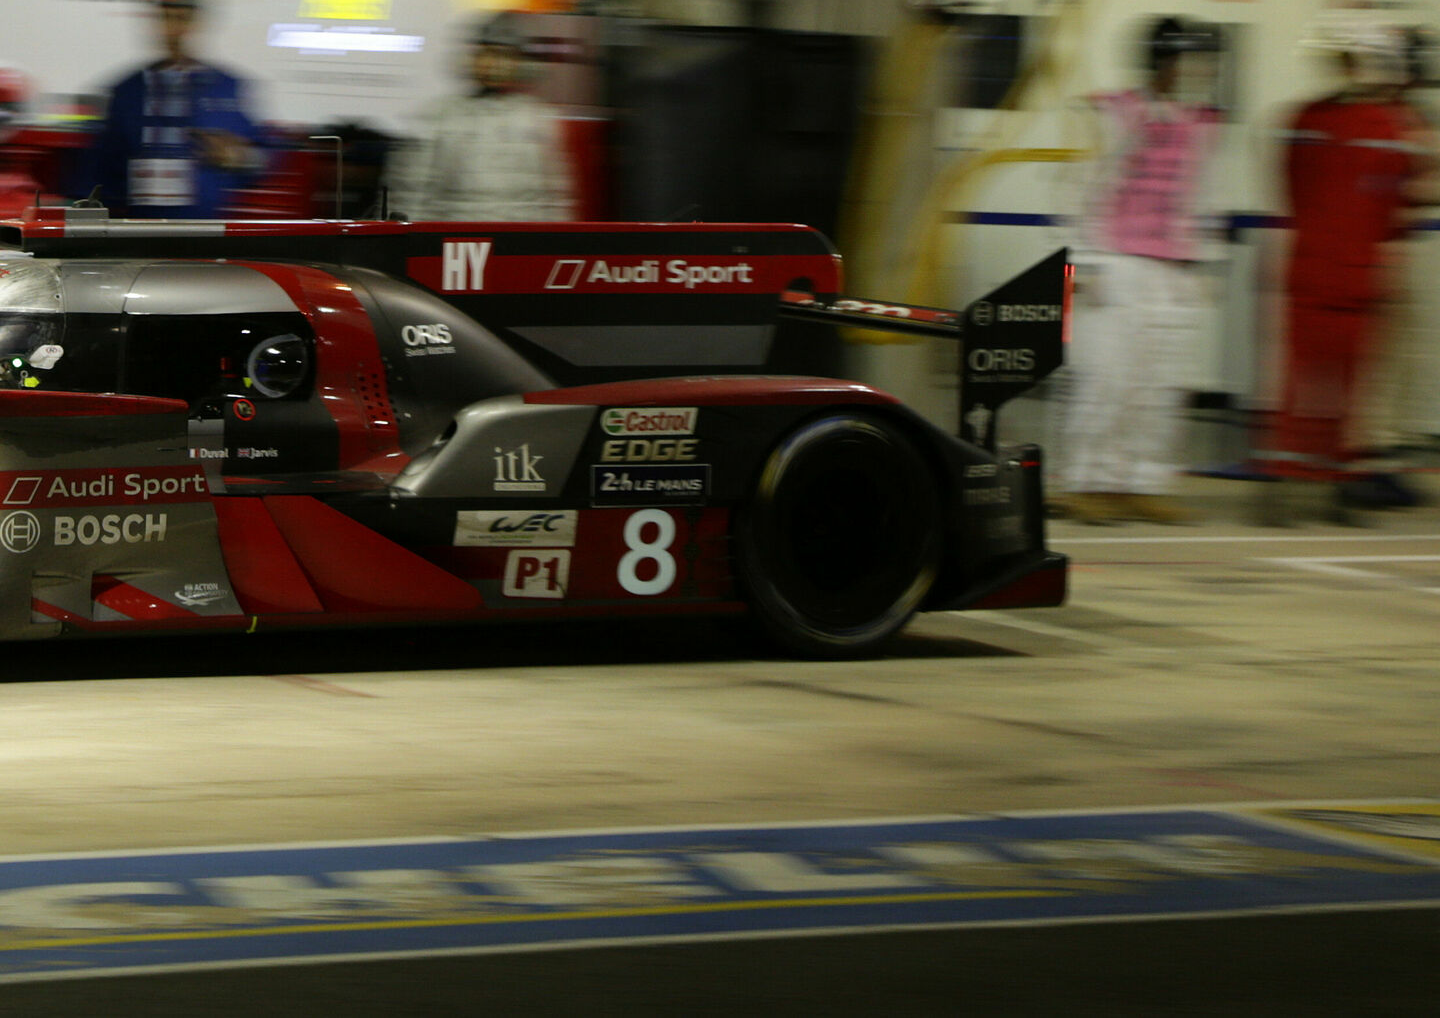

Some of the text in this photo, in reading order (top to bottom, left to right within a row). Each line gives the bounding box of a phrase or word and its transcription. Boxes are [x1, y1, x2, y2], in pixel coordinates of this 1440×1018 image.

[442, 241, 491, 291] HY
[586, 259, 753, 289] Audi Sport
[997, 304, 1062, 323] BOSCH
[401, 323, 453, 346] ORIS
[968, 347, 1036, 372] ORIS
[623, 410, 691, 433] Castrol
[199, 447, 229, 459] Duval
[249, 447, 279, 460] Jarvis
[601, 439, 701, 462] EDGE
[493, 443, 546, 483] itk
[47, 472, 206, 501] Audi Sport
[633, 479, 657, 492] LE
[656, 478, 703, 491] MANS
[53, 513, 168, 546] BOSCH
[489, 513, 565, 533] WEC
[616, 508, 677, 596] 8
[515, 556, 560, 591] P1
